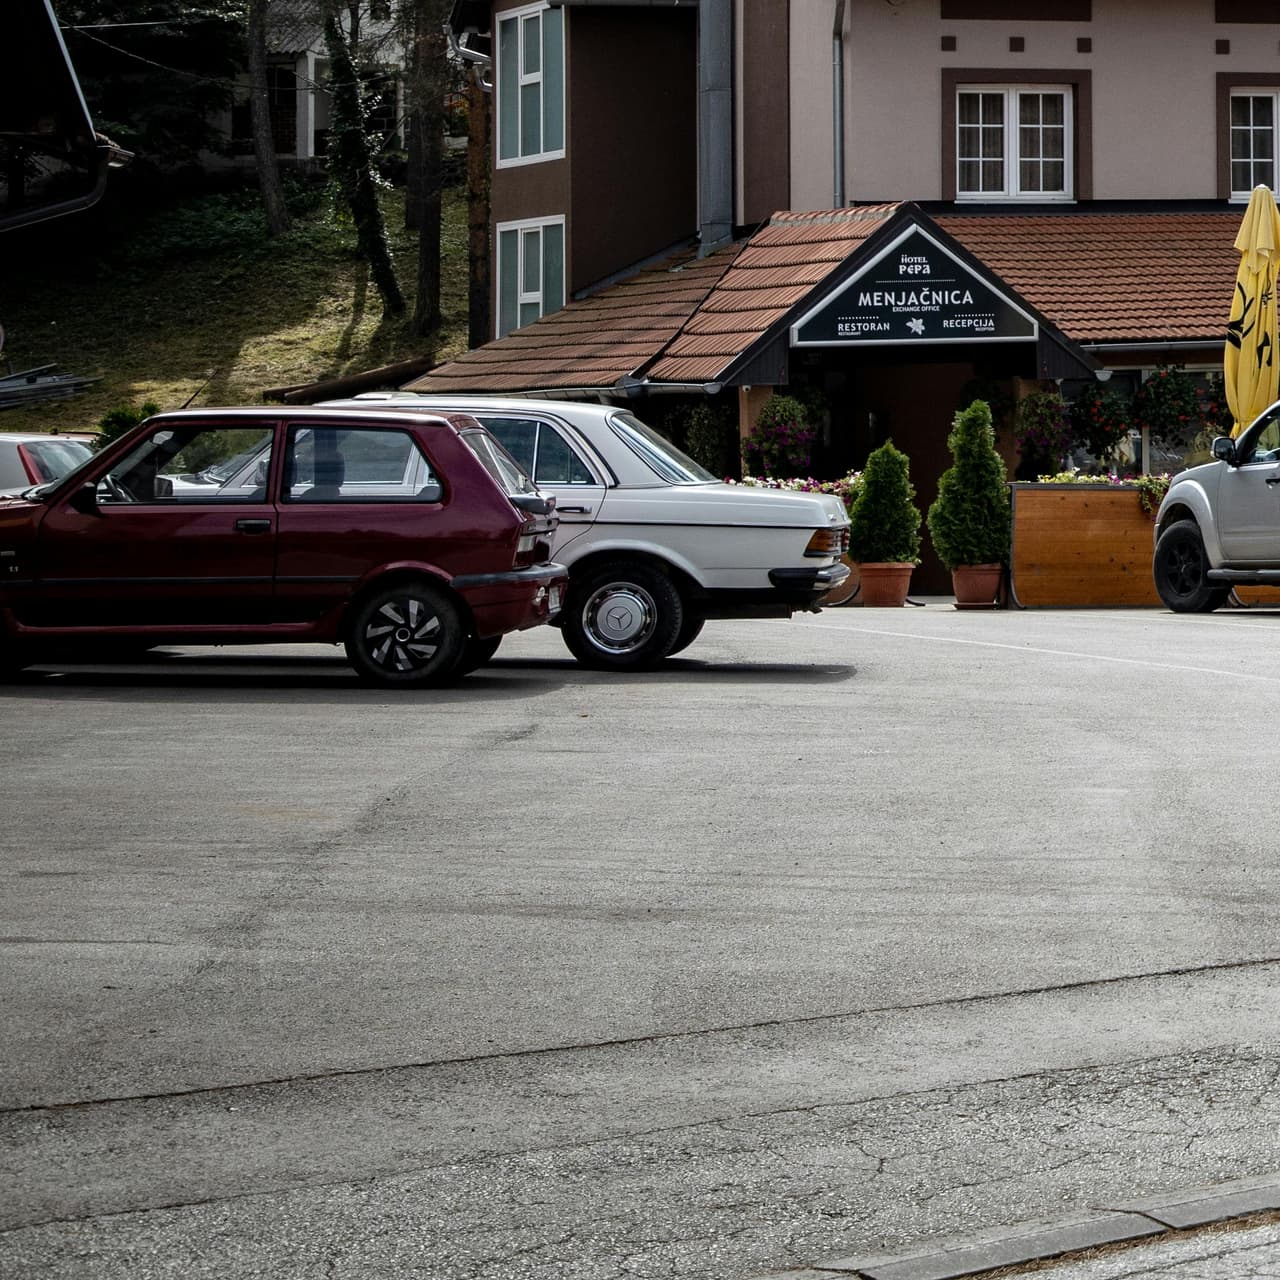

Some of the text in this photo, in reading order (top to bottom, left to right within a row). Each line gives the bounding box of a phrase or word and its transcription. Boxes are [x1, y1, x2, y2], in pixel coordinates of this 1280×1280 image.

[901, 255, 928, 264] HOTEL
[858, 287, 974, 307] MENJAČNICA
[892, 305, 921, 313] EXCHANGE
[838, 322, 890, 332] RESTORAN
[943, 319, 995, 328] RECEPCIJA
